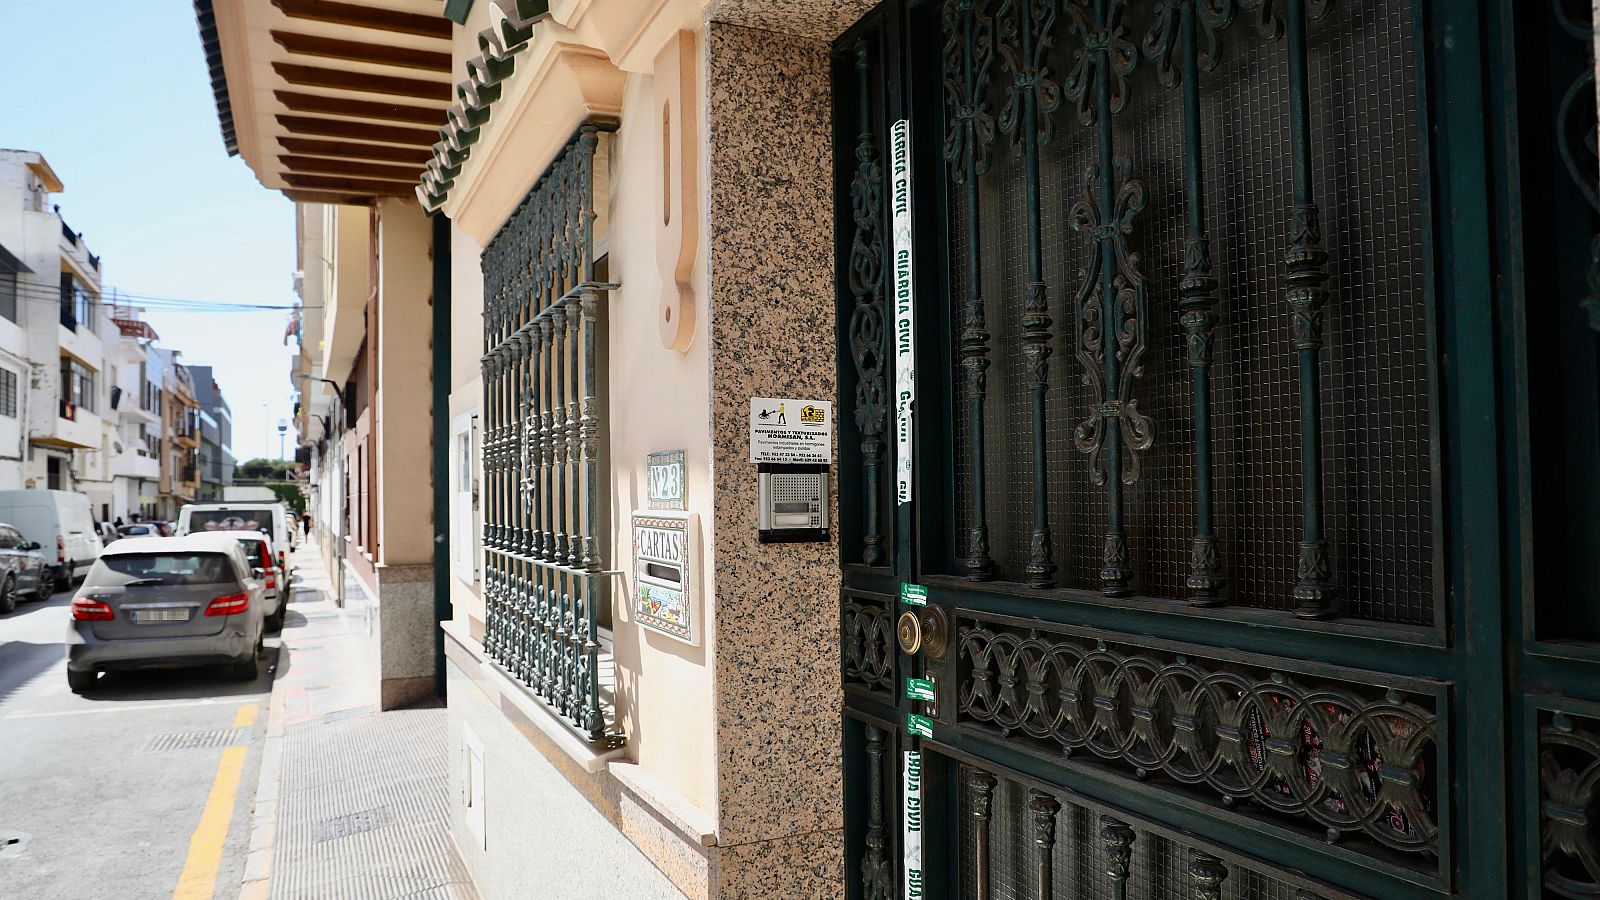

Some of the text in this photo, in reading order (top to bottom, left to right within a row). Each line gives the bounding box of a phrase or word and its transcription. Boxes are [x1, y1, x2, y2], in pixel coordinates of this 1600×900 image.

[896, 178, 907, 217] CIVIL
[898, 250, 910, 357] GUARDIA CIVIL
[640, 529, 679, 561] CARTAS
[908, 797, 920, 833] CIVIL
